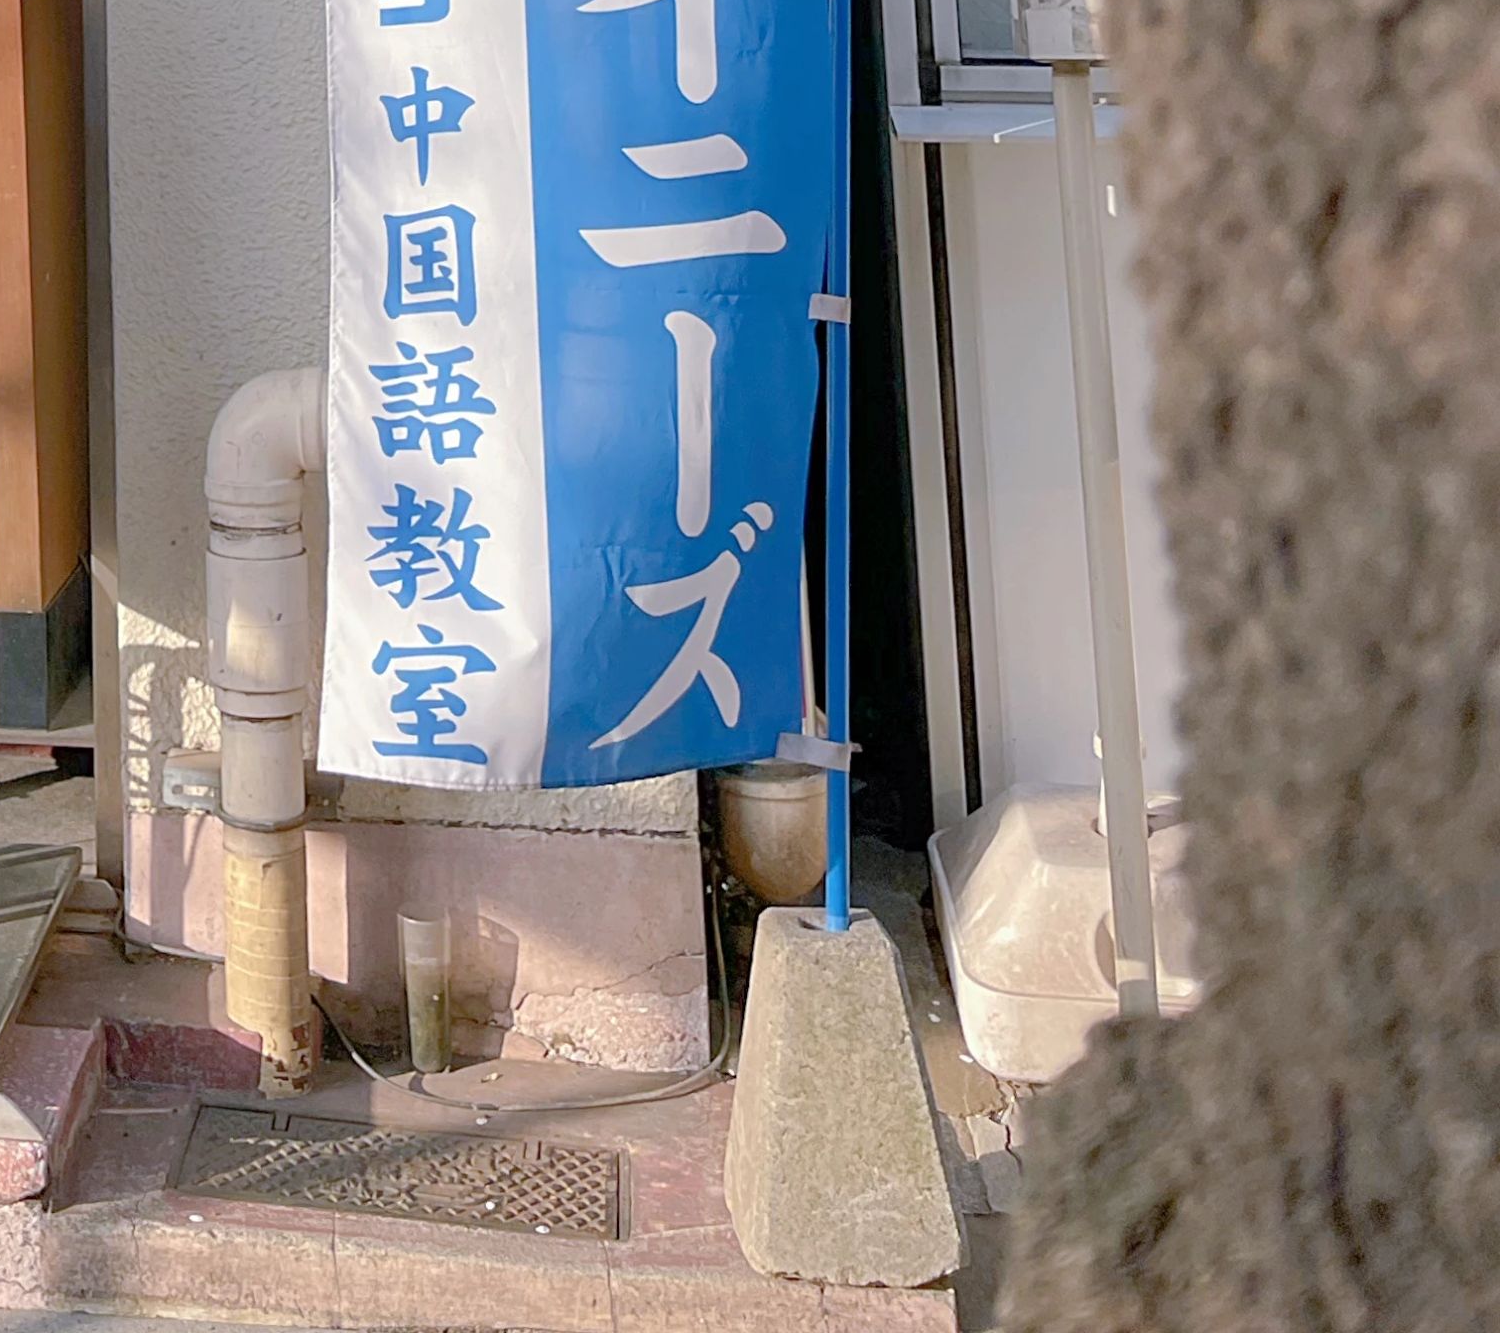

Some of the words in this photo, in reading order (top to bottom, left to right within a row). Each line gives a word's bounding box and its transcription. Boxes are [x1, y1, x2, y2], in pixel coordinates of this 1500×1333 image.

[367, 65, 504, 767] 中国語教室
